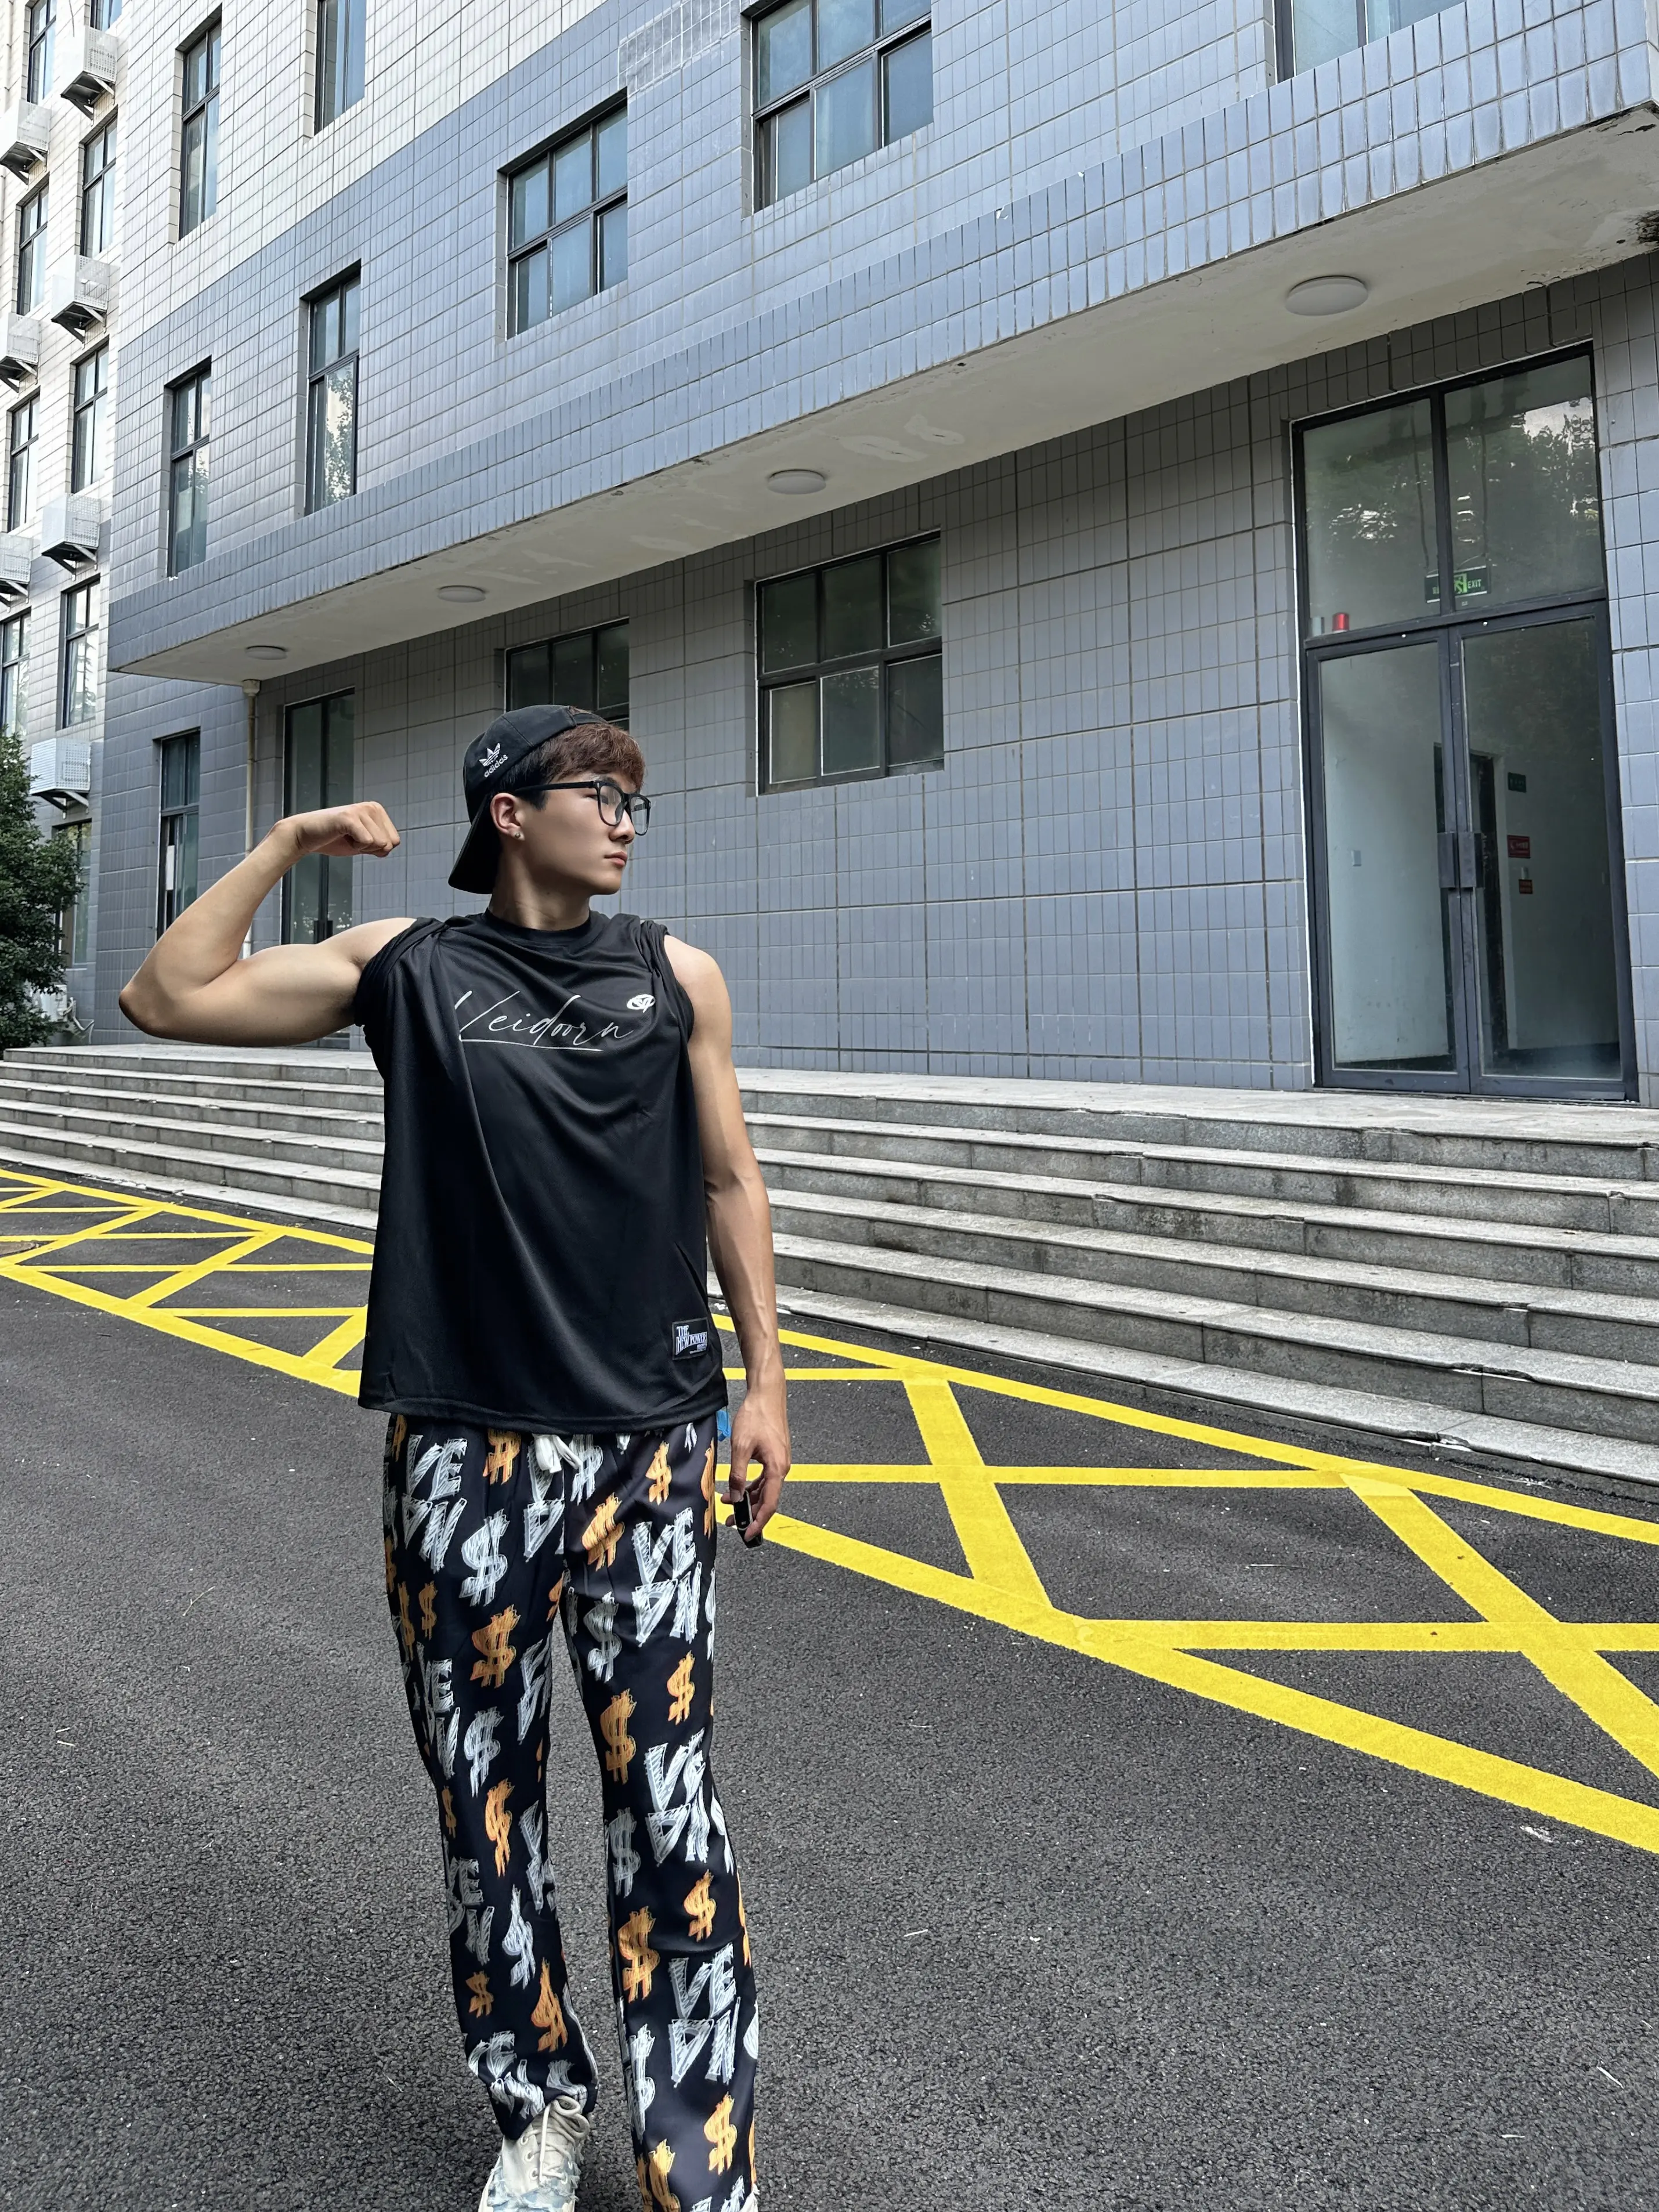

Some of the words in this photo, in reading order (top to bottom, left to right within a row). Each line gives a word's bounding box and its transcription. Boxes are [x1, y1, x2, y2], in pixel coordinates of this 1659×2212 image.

[1468, 579, 1481, 589] EXIT
[484, 754, 508, 778] adidas
[676, 1325, 689, 1337] THE
[675, 1335, 690, 1355] NEW
[689, 1331, 707, 1346] POWER
